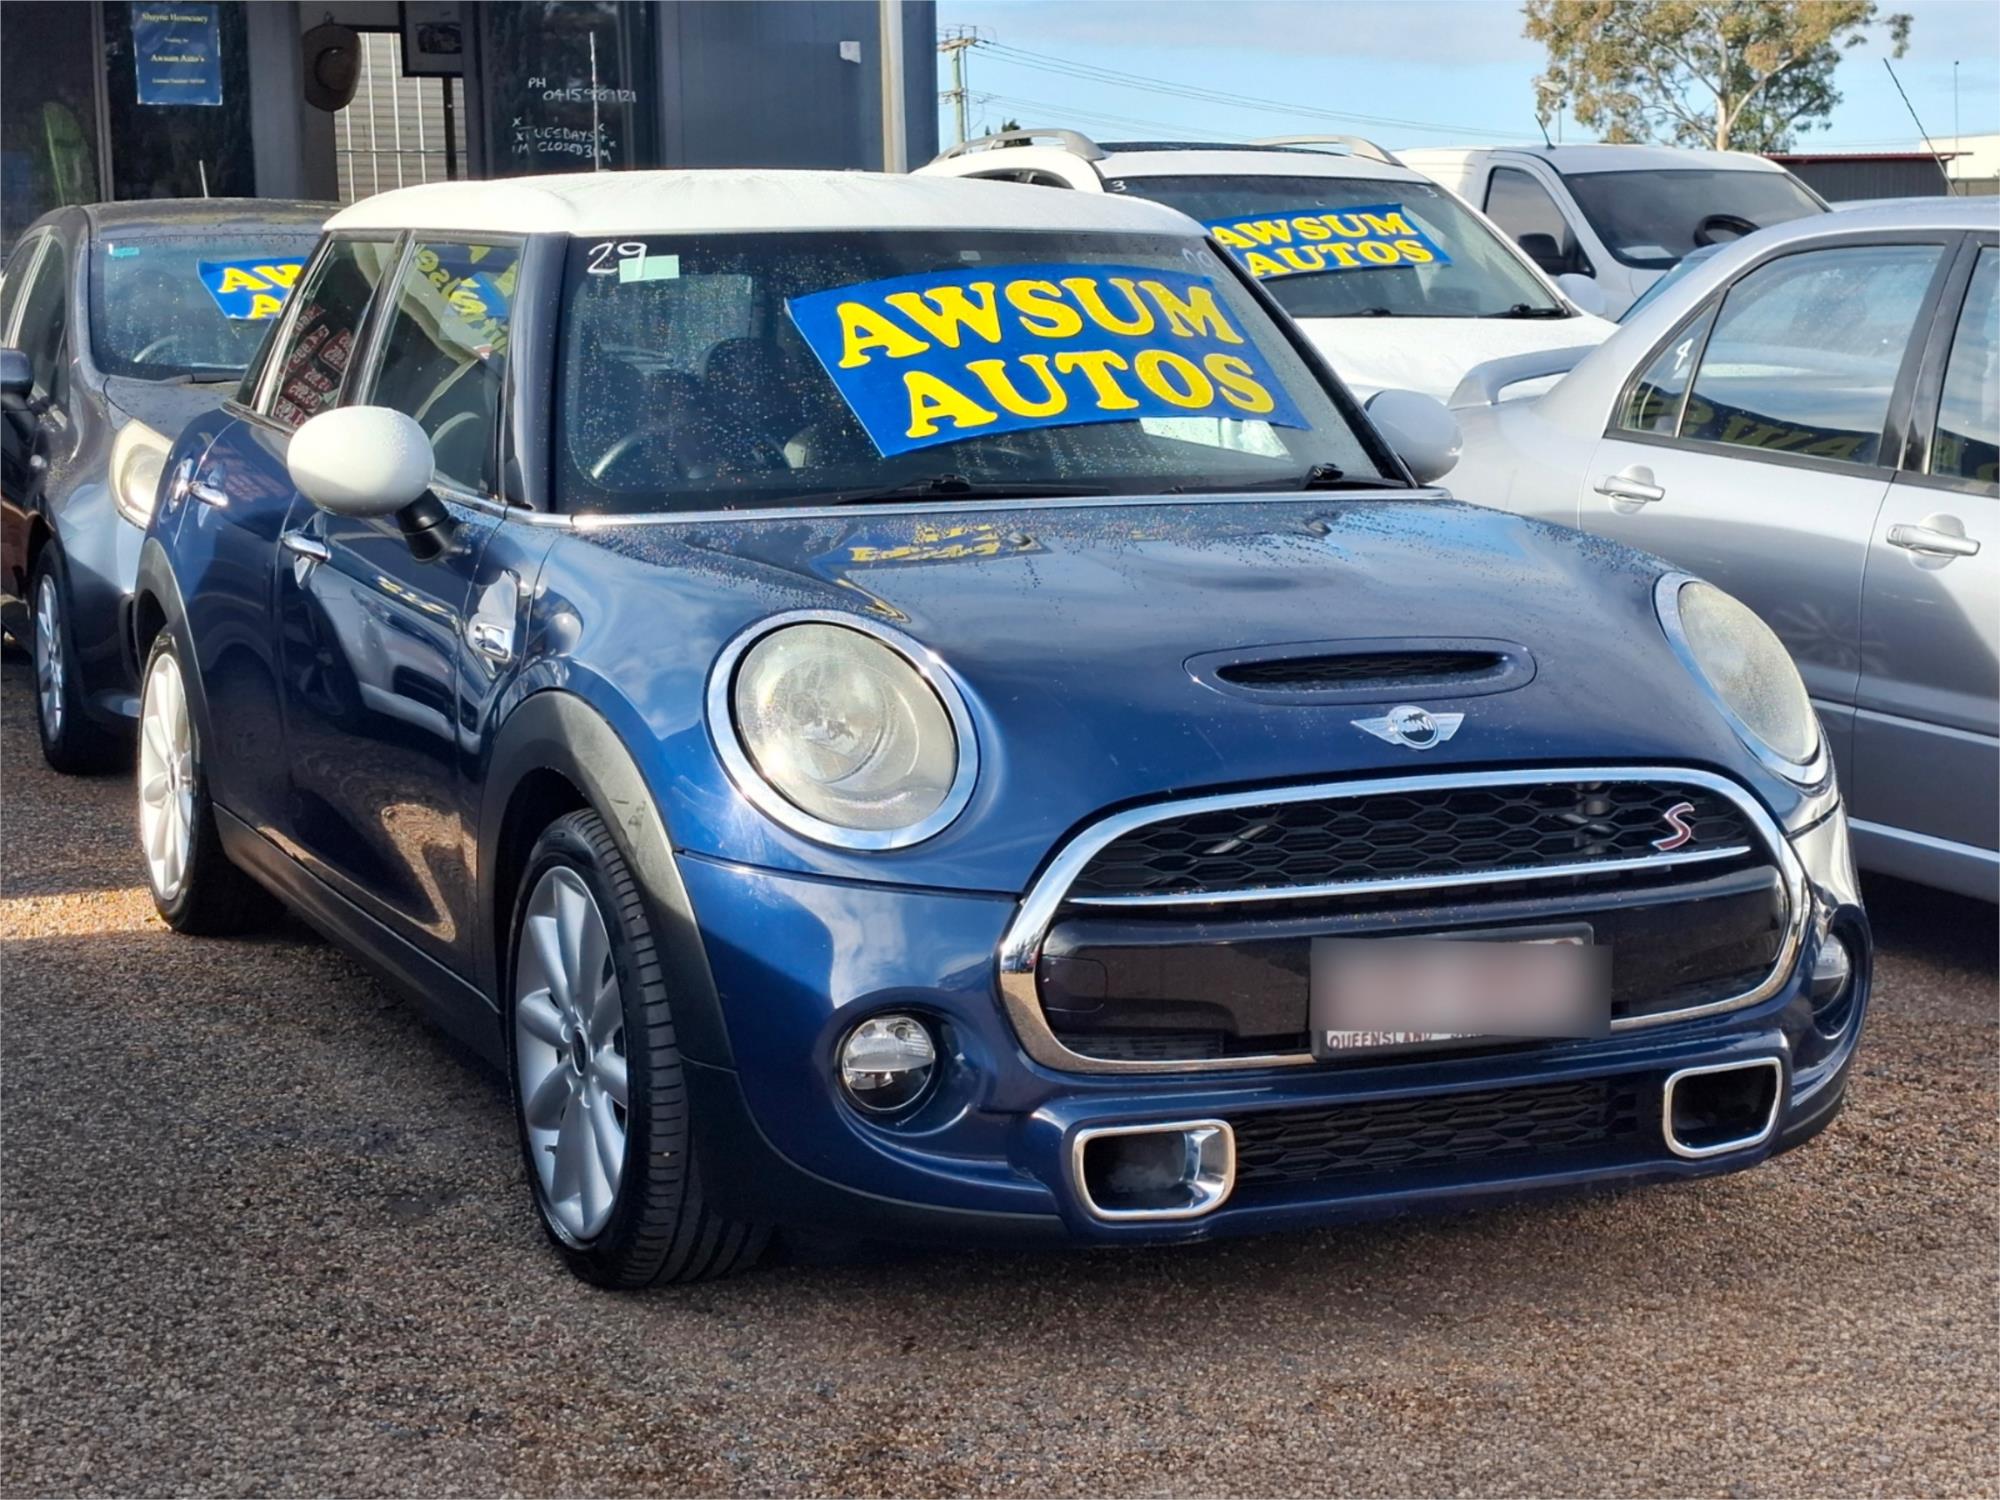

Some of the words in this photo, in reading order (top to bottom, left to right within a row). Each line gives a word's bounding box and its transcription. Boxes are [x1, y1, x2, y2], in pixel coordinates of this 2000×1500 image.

[528, 77, 546, 88] PH
[1211, 211, 1419, 249] AWSUM
[586, 241, 648, 279] 29
[1245, 239, 1434, 278] AUTOS
[835, 276, 1246, 370] AWSUM
[1674, 338, 1694, 370] 4
[903, 348, 1277, 440] AUTOS
[1651, 801, 1695, 851] S
